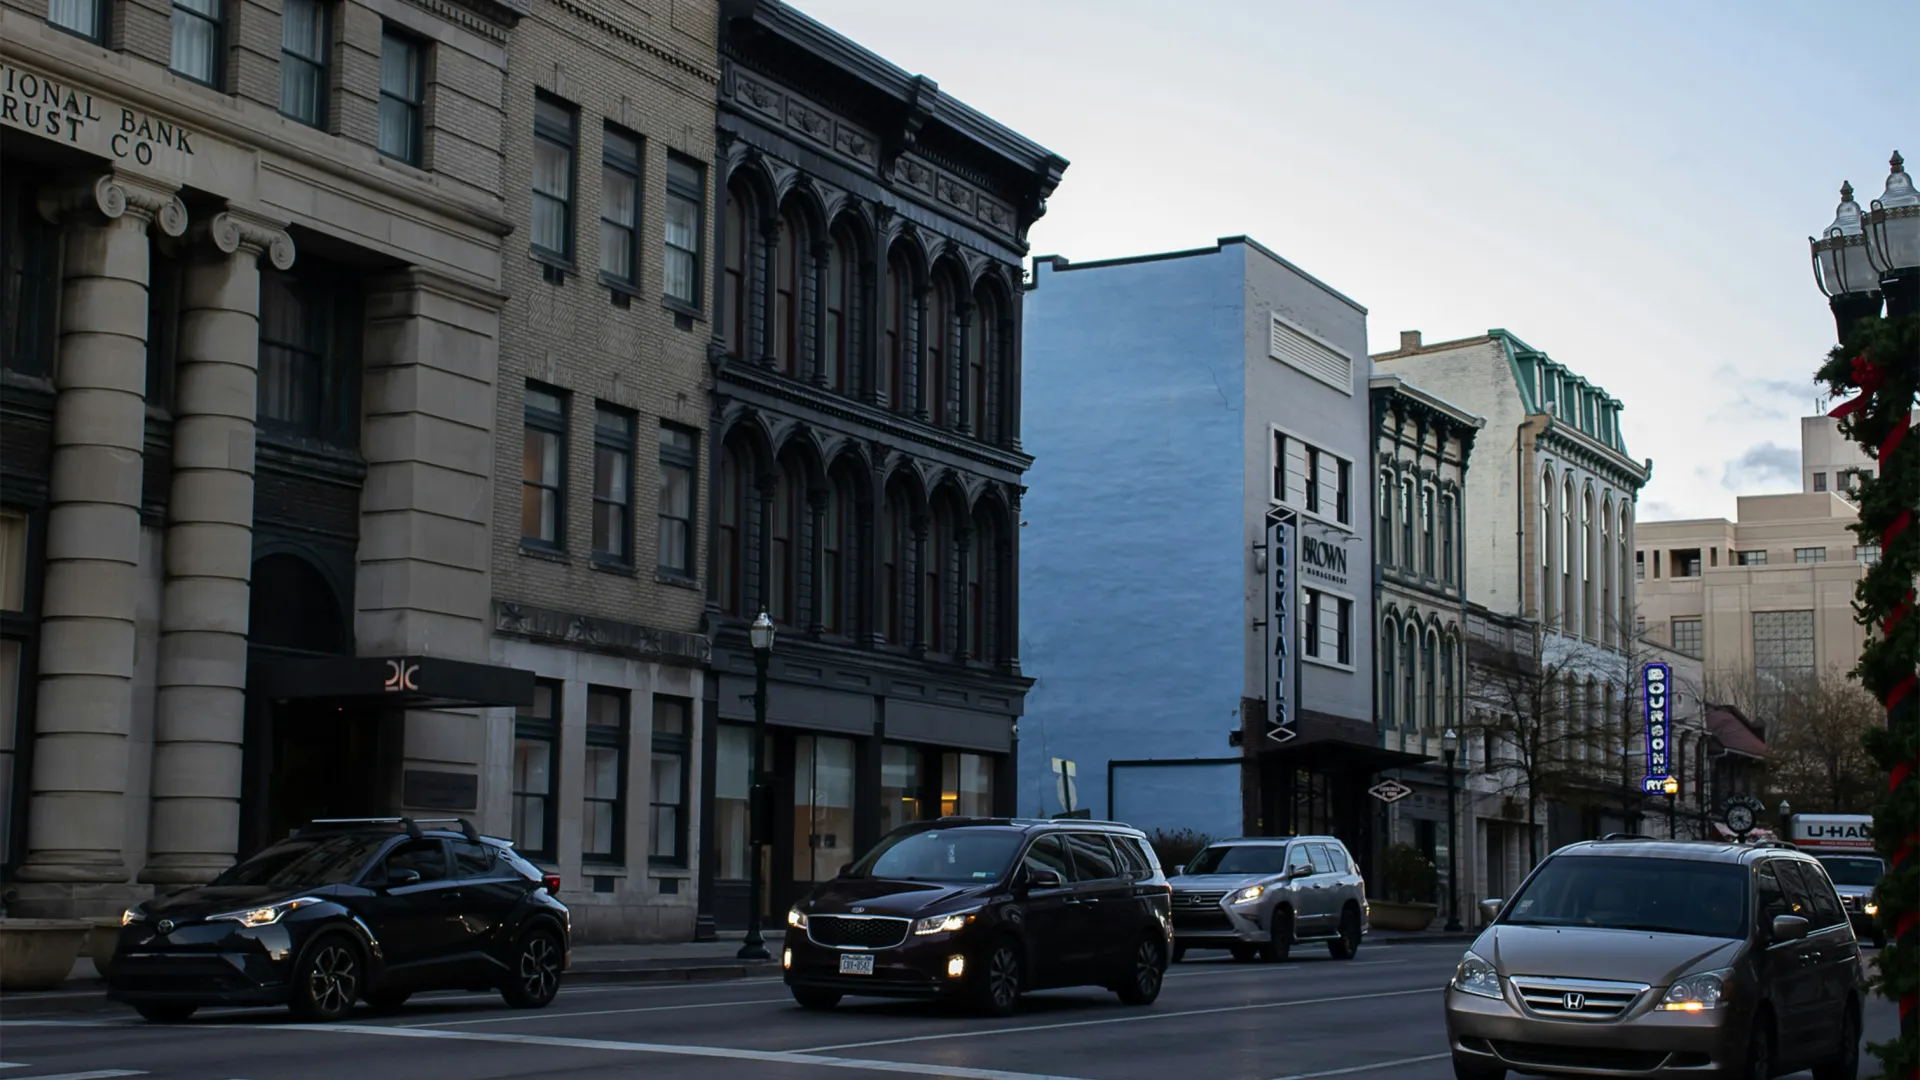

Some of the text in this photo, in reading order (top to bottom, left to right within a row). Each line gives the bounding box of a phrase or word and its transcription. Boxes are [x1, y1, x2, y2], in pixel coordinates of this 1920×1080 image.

[0, 65, 194, 155] IONAL BANK
[111, 134, 153, 165] CO
[1303, 535, 1347, 575] BROWN
[1307, 567, 1347, 585] MANAGEMENT
[1275, 523, 1288, 724] COCKTAILS
[1647, 668, 1665, 764] BOURBON
[1646, 780, 1666, 790] RY
[1807, 825, 1871, 838] U-HAU
